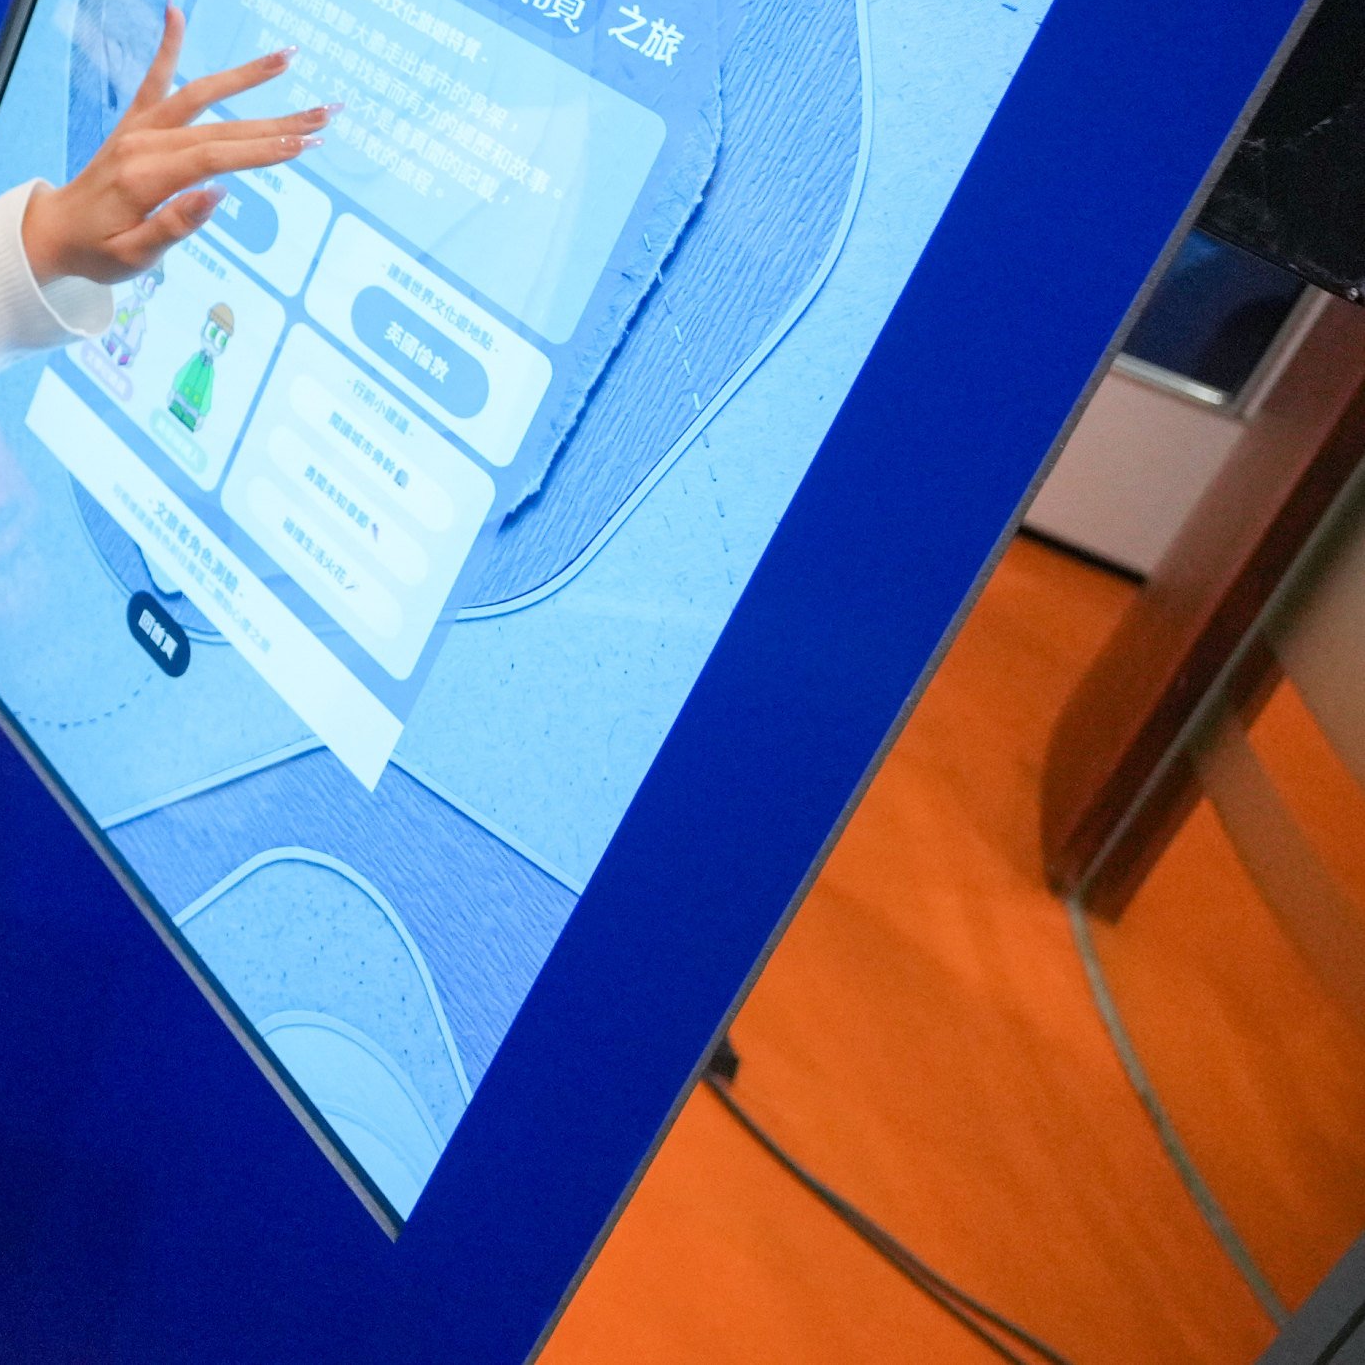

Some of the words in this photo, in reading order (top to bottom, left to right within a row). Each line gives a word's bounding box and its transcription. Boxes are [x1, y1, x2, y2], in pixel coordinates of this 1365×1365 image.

[608, 3, 686, 67] 之旅
[383, 320, 451, 385] 英國倫敦
